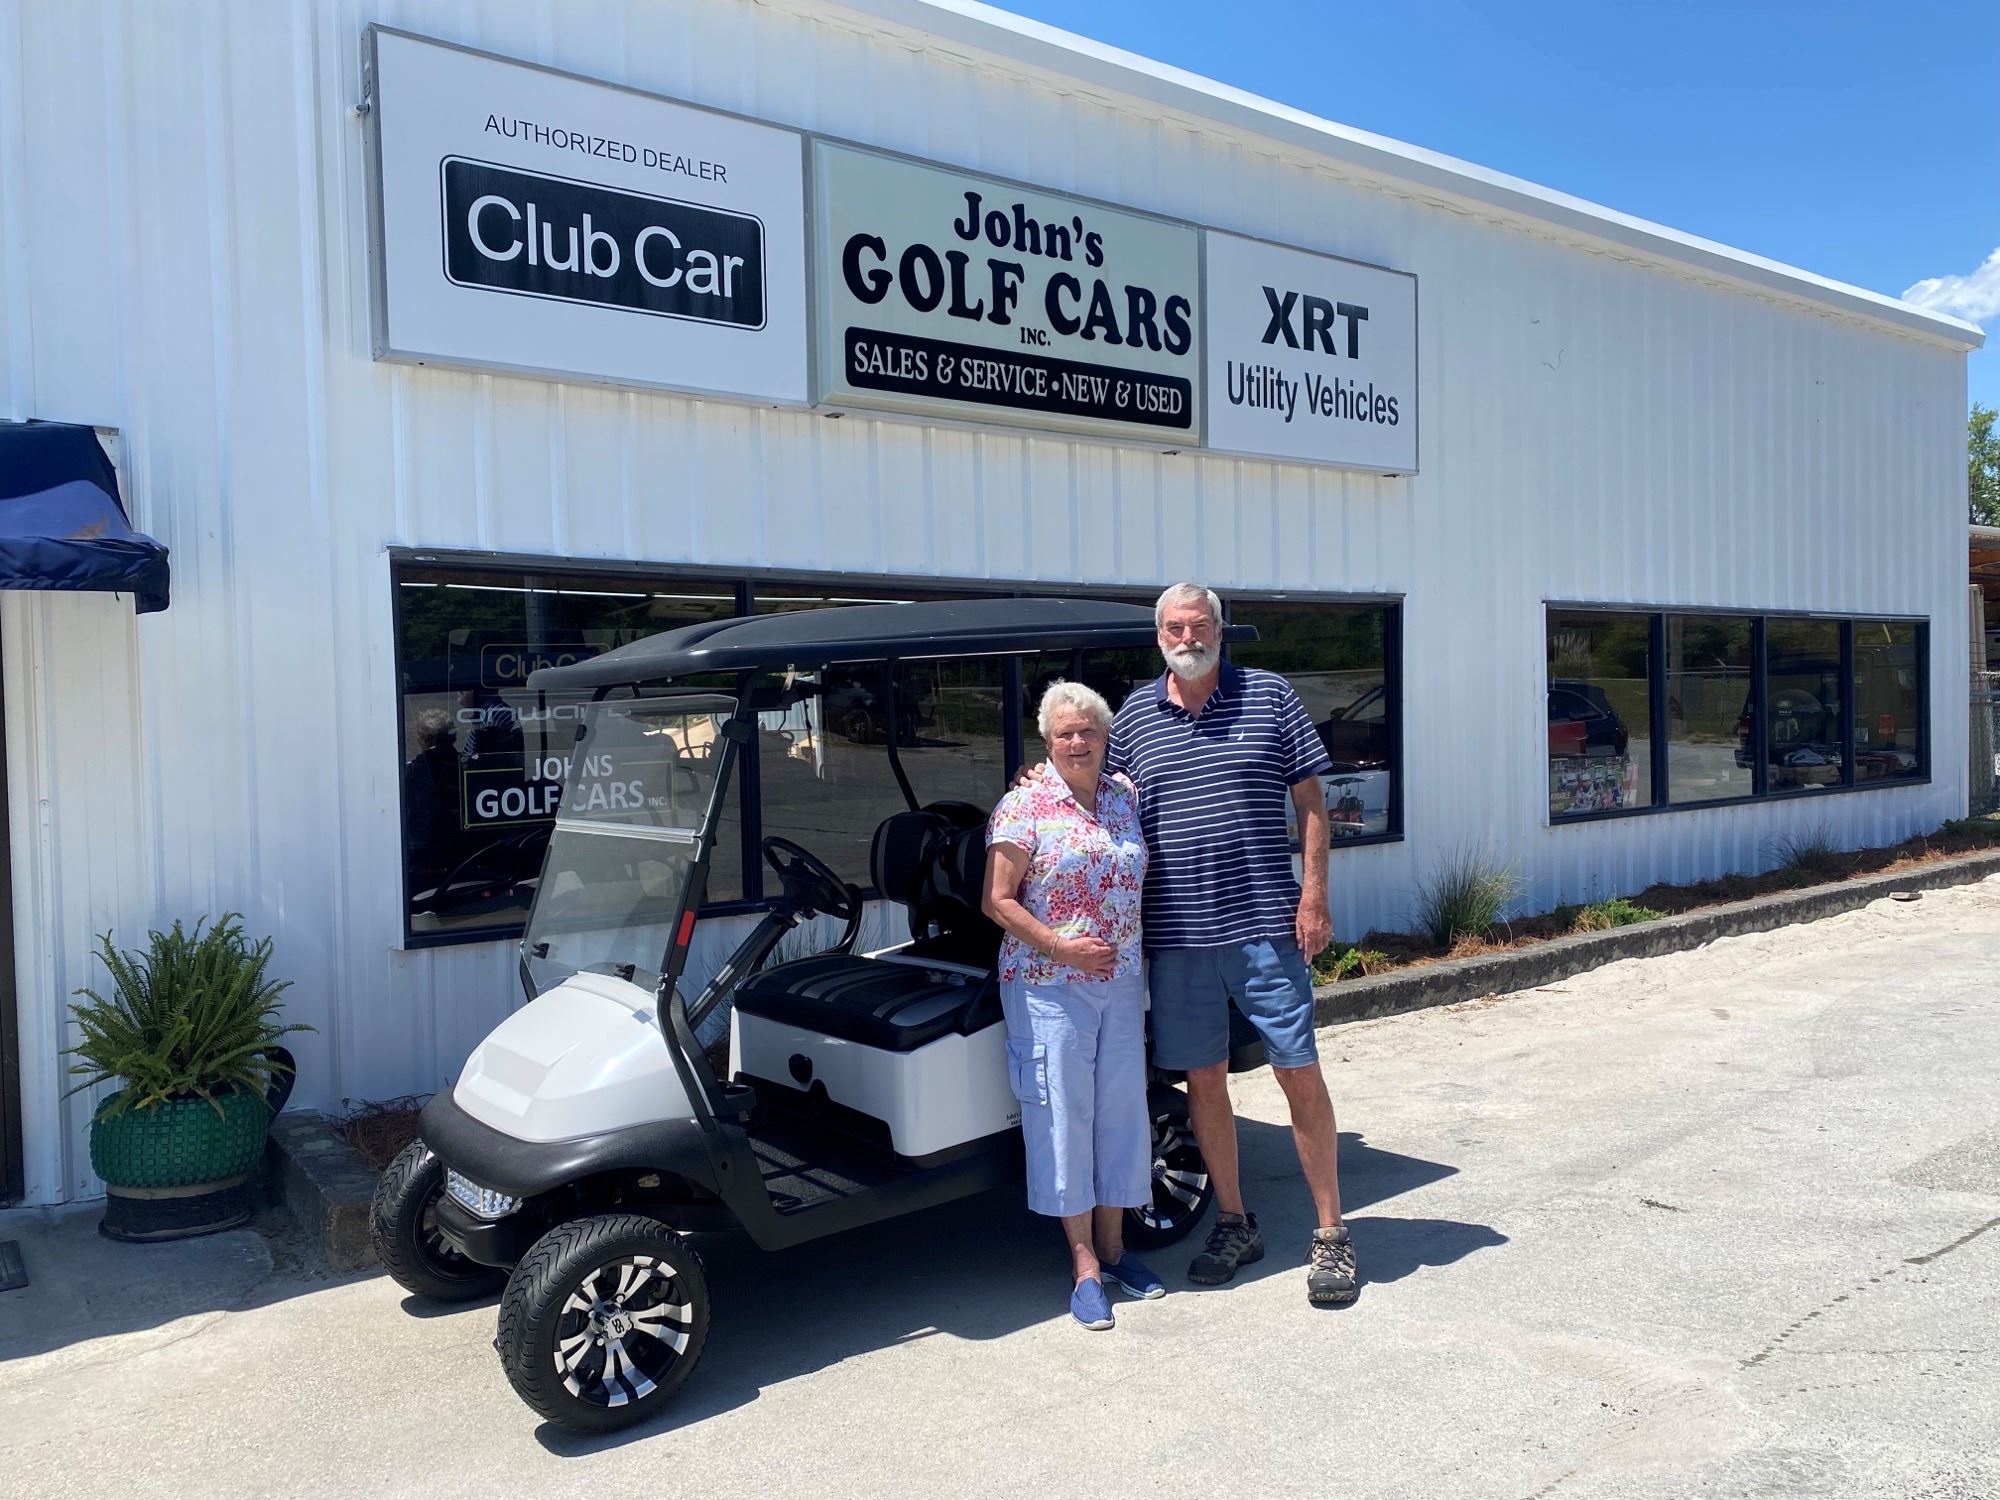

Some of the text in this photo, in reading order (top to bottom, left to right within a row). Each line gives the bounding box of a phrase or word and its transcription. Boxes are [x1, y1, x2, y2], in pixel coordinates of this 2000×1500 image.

[484, 114, 728, 183] AUTHORIZED DEALER
[467, 194, 744, 299] Club Car
[953, 191, 1104, 267] John's
[842, 233, 1192, 355] GOLF CARS
[1261, 285, 1369, 360] XRT
[1020, 327, 1052, 346] INC.
[854, 341, 1183, 414] SALES & SERVICE NEW & USED
[1227, 360, 1399, 426] Utility Vehicles
[475, 786, 559, 818] GOLF
[571, 780, 645, 812] CARS
